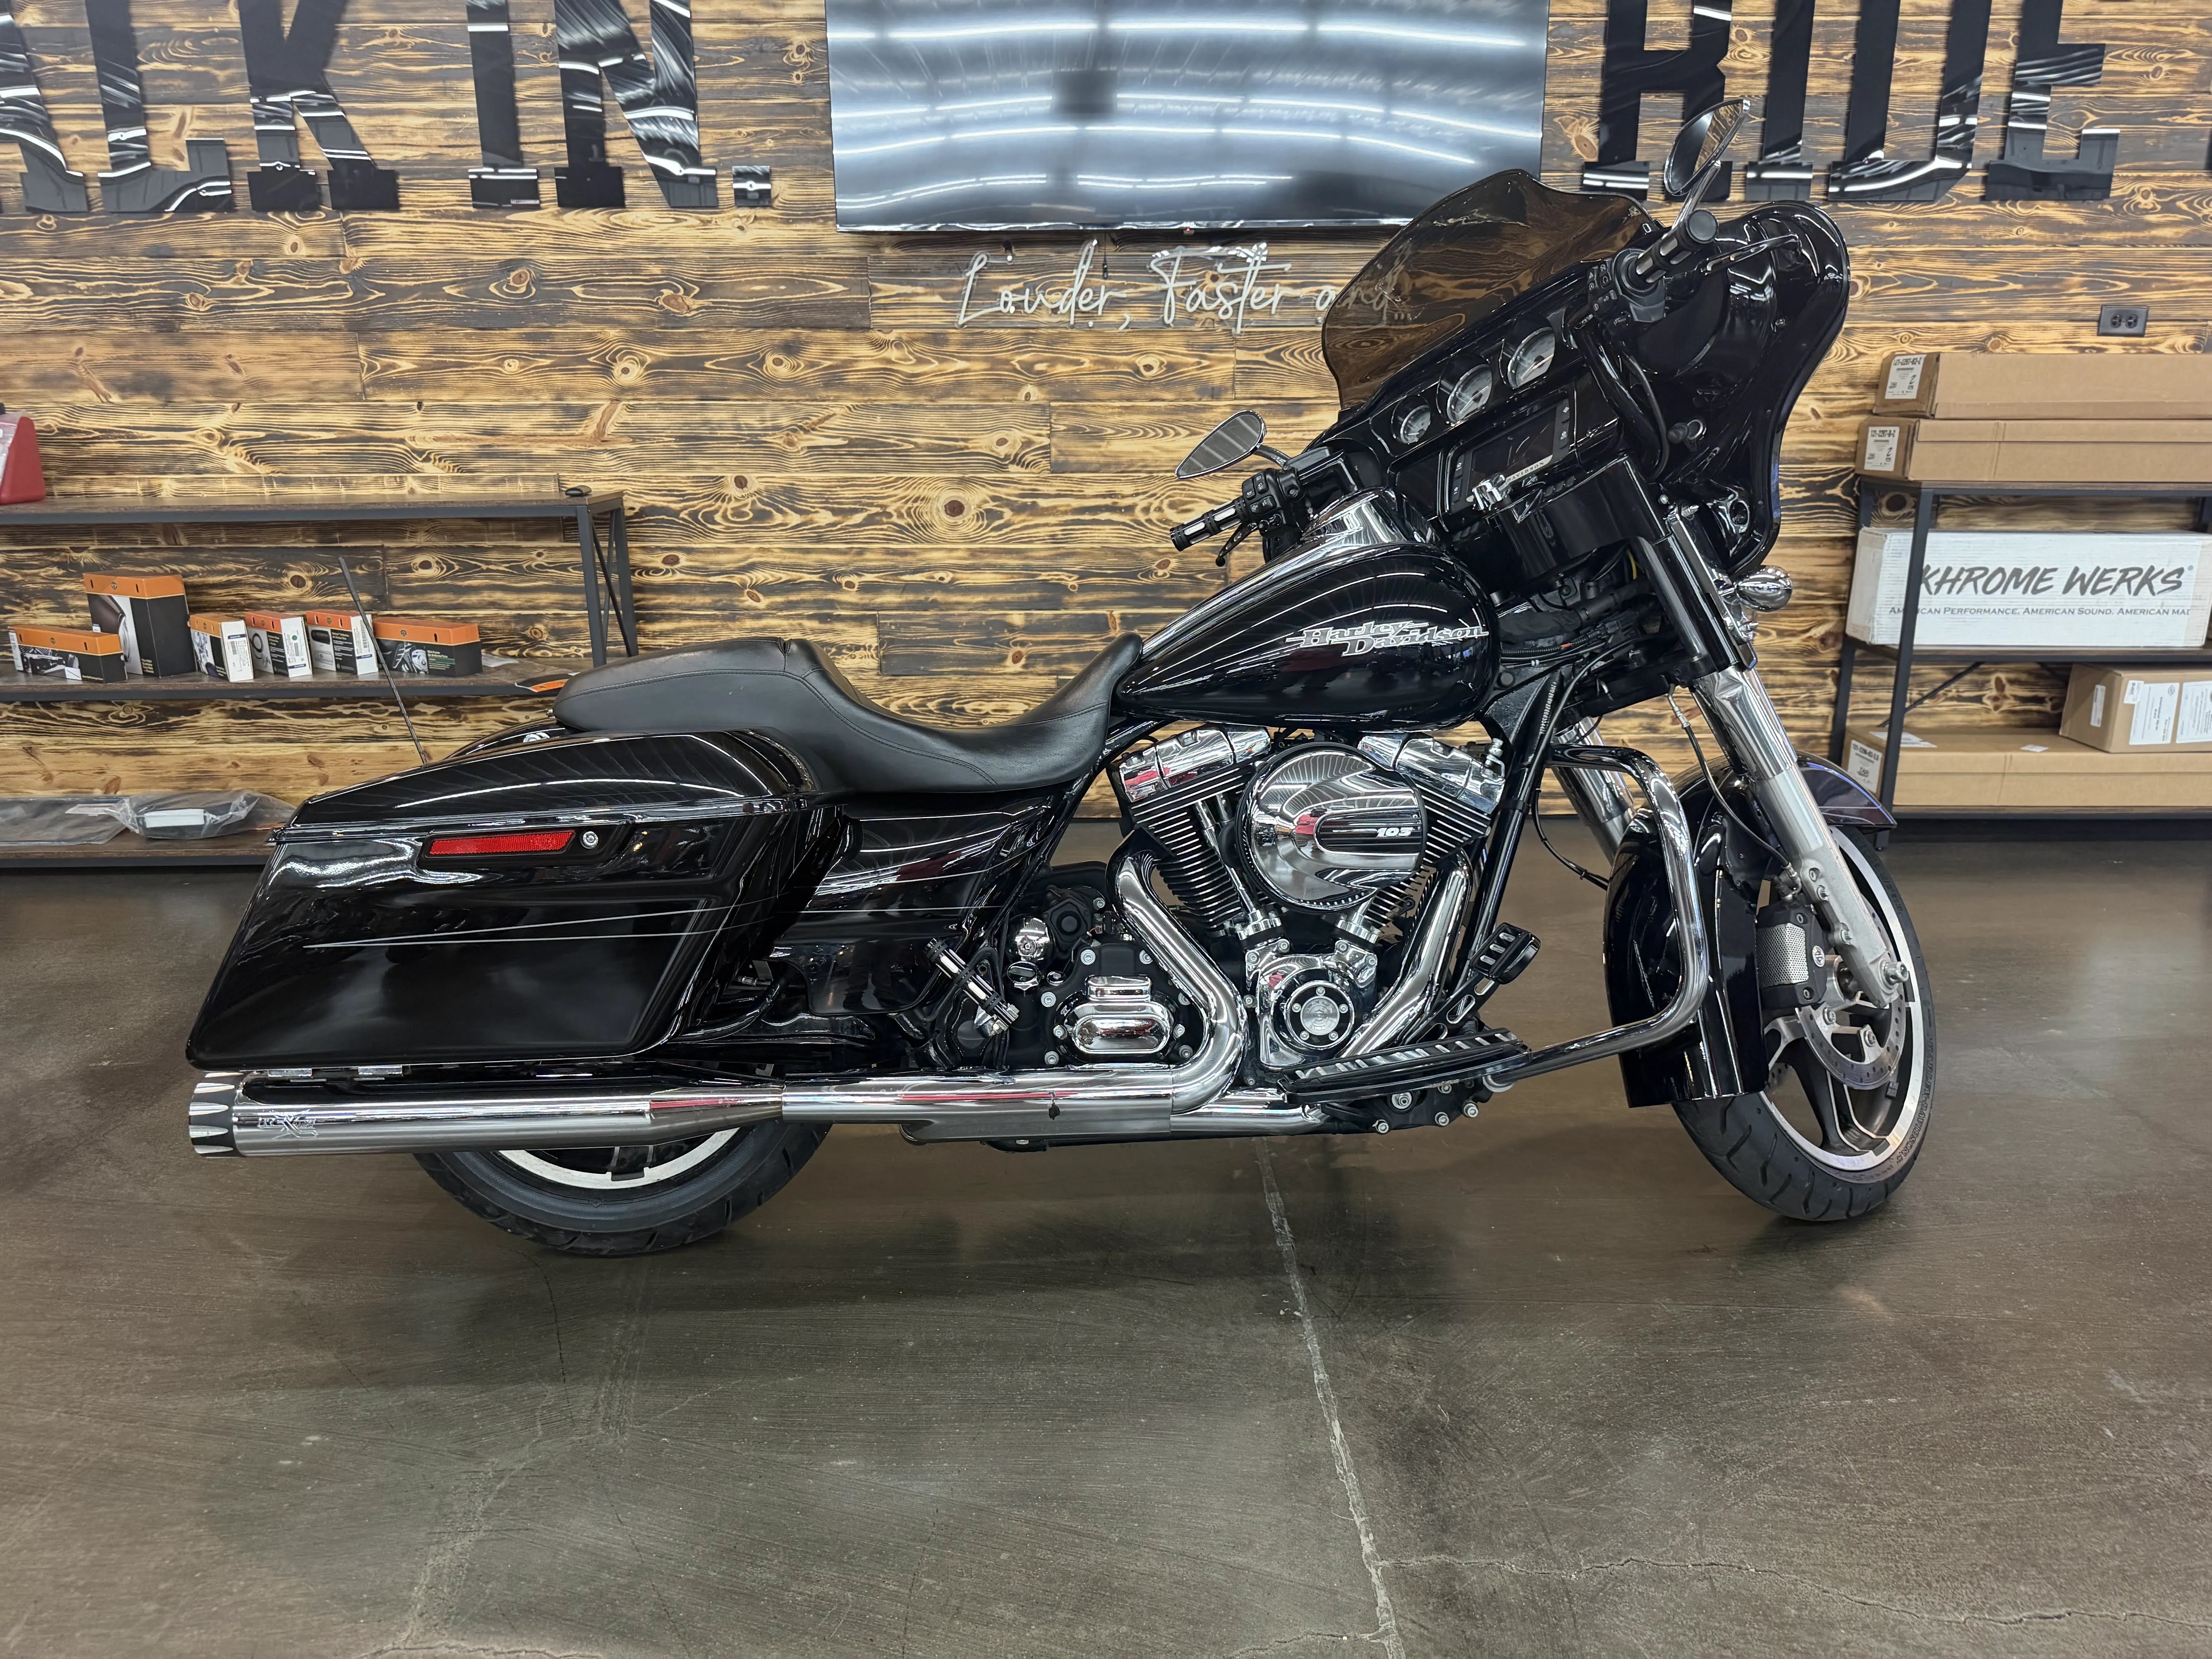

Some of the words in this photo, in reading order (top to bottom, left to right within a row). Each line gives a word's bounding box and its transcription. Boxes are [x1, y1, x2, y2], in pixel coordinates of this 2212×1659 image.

[1582, 0, 2121, 201] RIDE
[956, 238, 1131, 331] Louder,
[1149, 242, 1302, 336] Faster
[1920, 564, 2059, 596] KHROME
[2062, 565, 2185, 596] WERKS
[1943, 606, 2020, 615] PERFORMANCE.
[2023, 607, 2075, 616] AMERICAN
[2077, 607, 2114, 616] SOUND.
[2117, 607, 2169, 616] AMERICAN
[1299, 620, 1429, 648] Harley
[1375, 827, 1414, 838] 103
